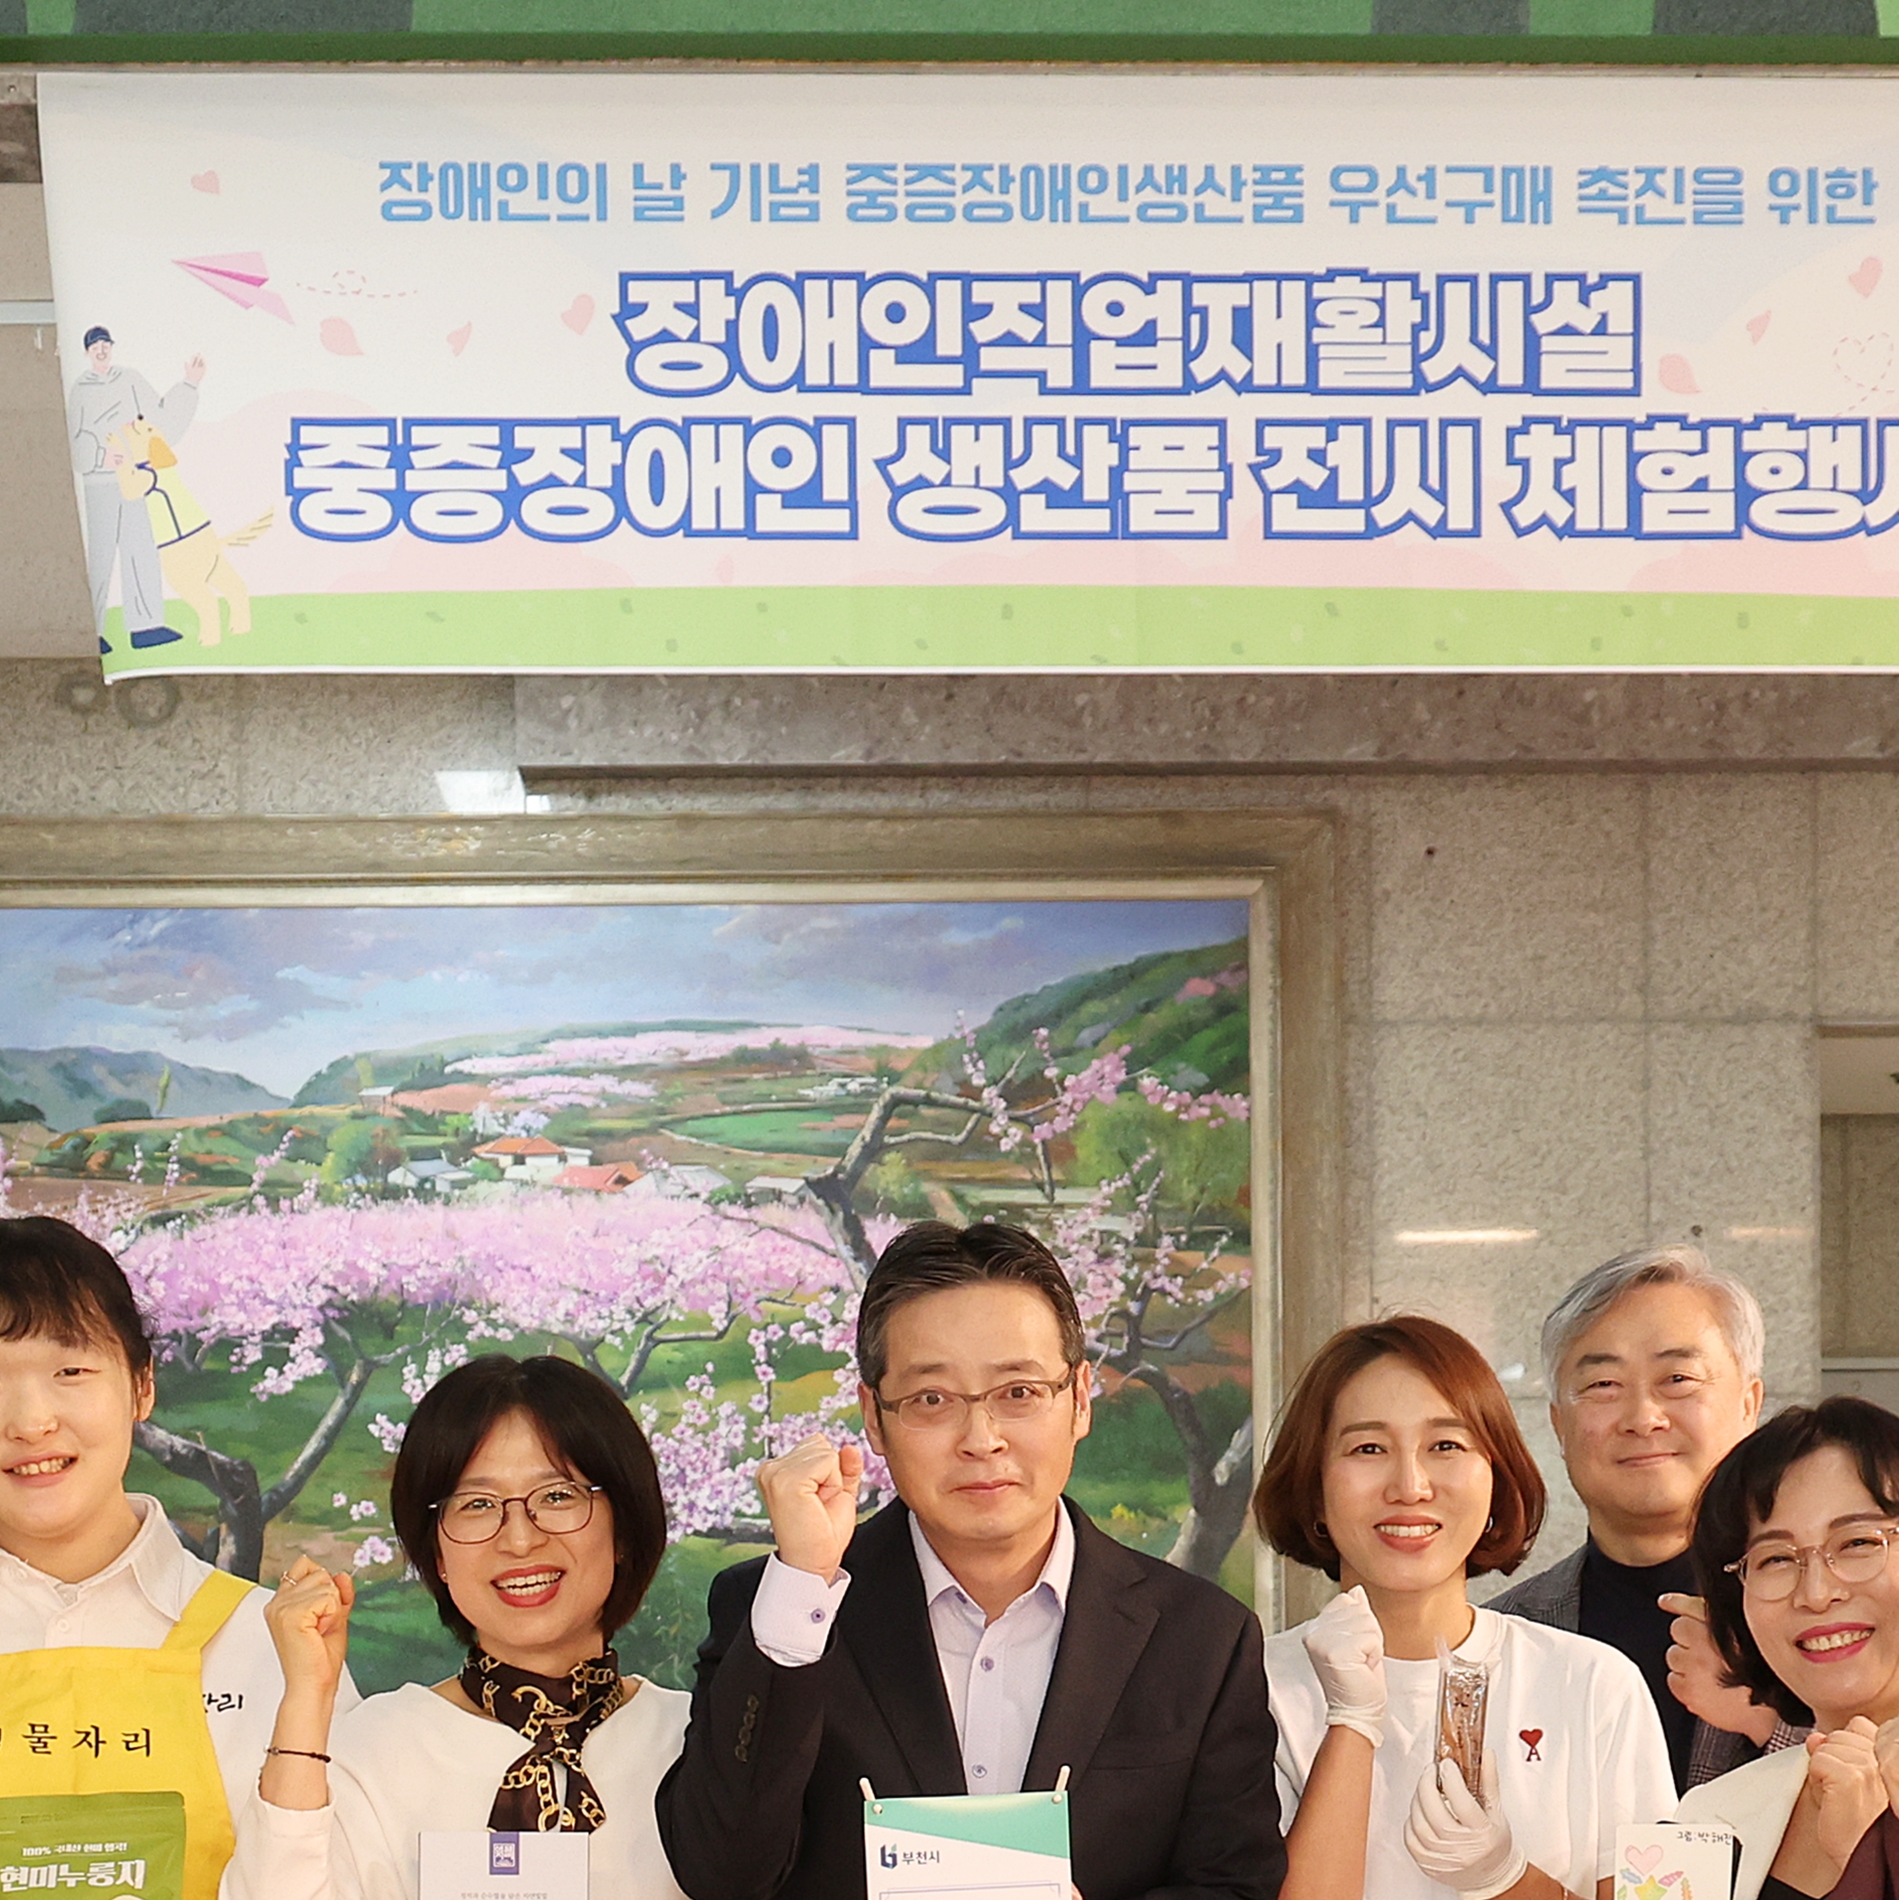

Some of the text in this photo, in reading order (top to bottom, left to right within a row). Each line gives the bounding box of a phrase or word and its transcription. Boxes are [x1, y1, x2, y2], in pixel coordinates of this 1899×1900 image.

[378, 159, 1879, 226] 장애인의 날 기념 중증장애인생산품 우선구매 촉진을 위한
[611, 267, 1642, 397] 장애인직업재활시설
[285, 416, 858, 541] 중증장애인
[874, 415, 1232, 540] 생산품
[1249, 415, 1482, 540] 전시
[0, 1859, 146, 1892] 현미누룽지
[22, 1846, 52, 1857] 100%
[901, 1850, 940, 1866] 부천시
